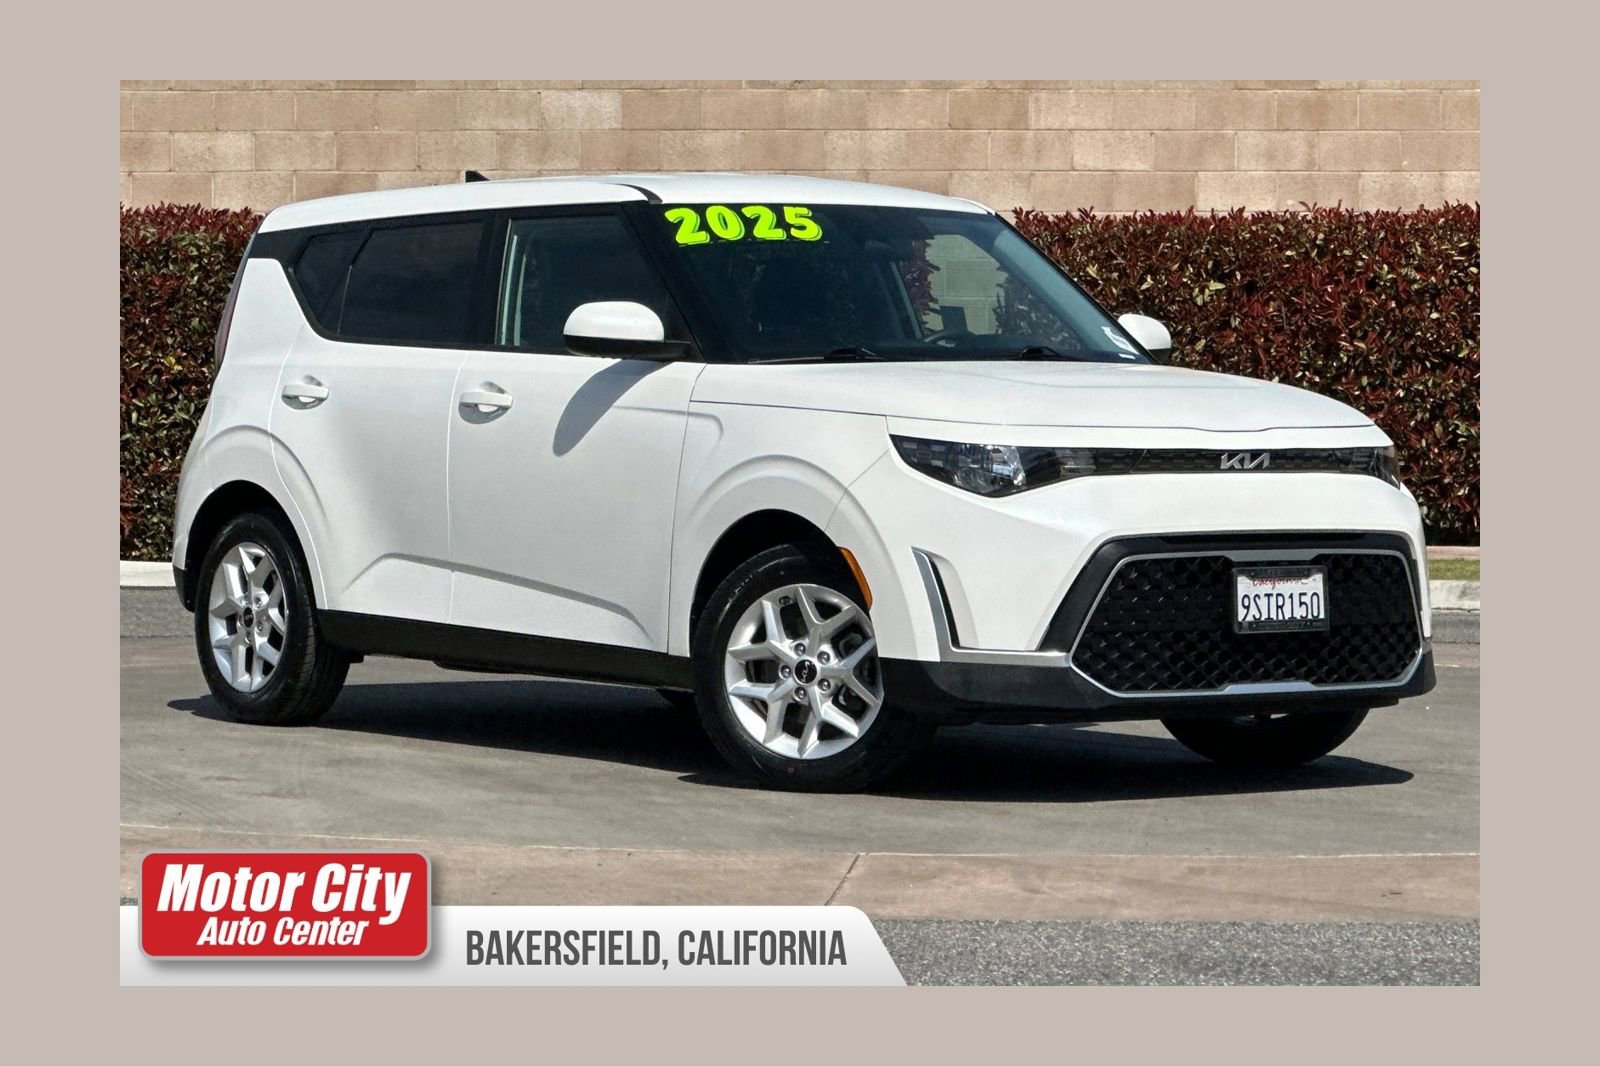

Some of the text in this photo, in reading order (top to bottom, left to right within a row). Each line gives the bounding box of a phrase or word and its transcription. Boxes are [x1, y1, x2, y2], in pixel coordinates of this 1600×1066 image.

[664, 205, 823, 245] 2025
[1220, 452, 1271, 470] KIA
[1241, 592, 1320, 621] 9SIR150
